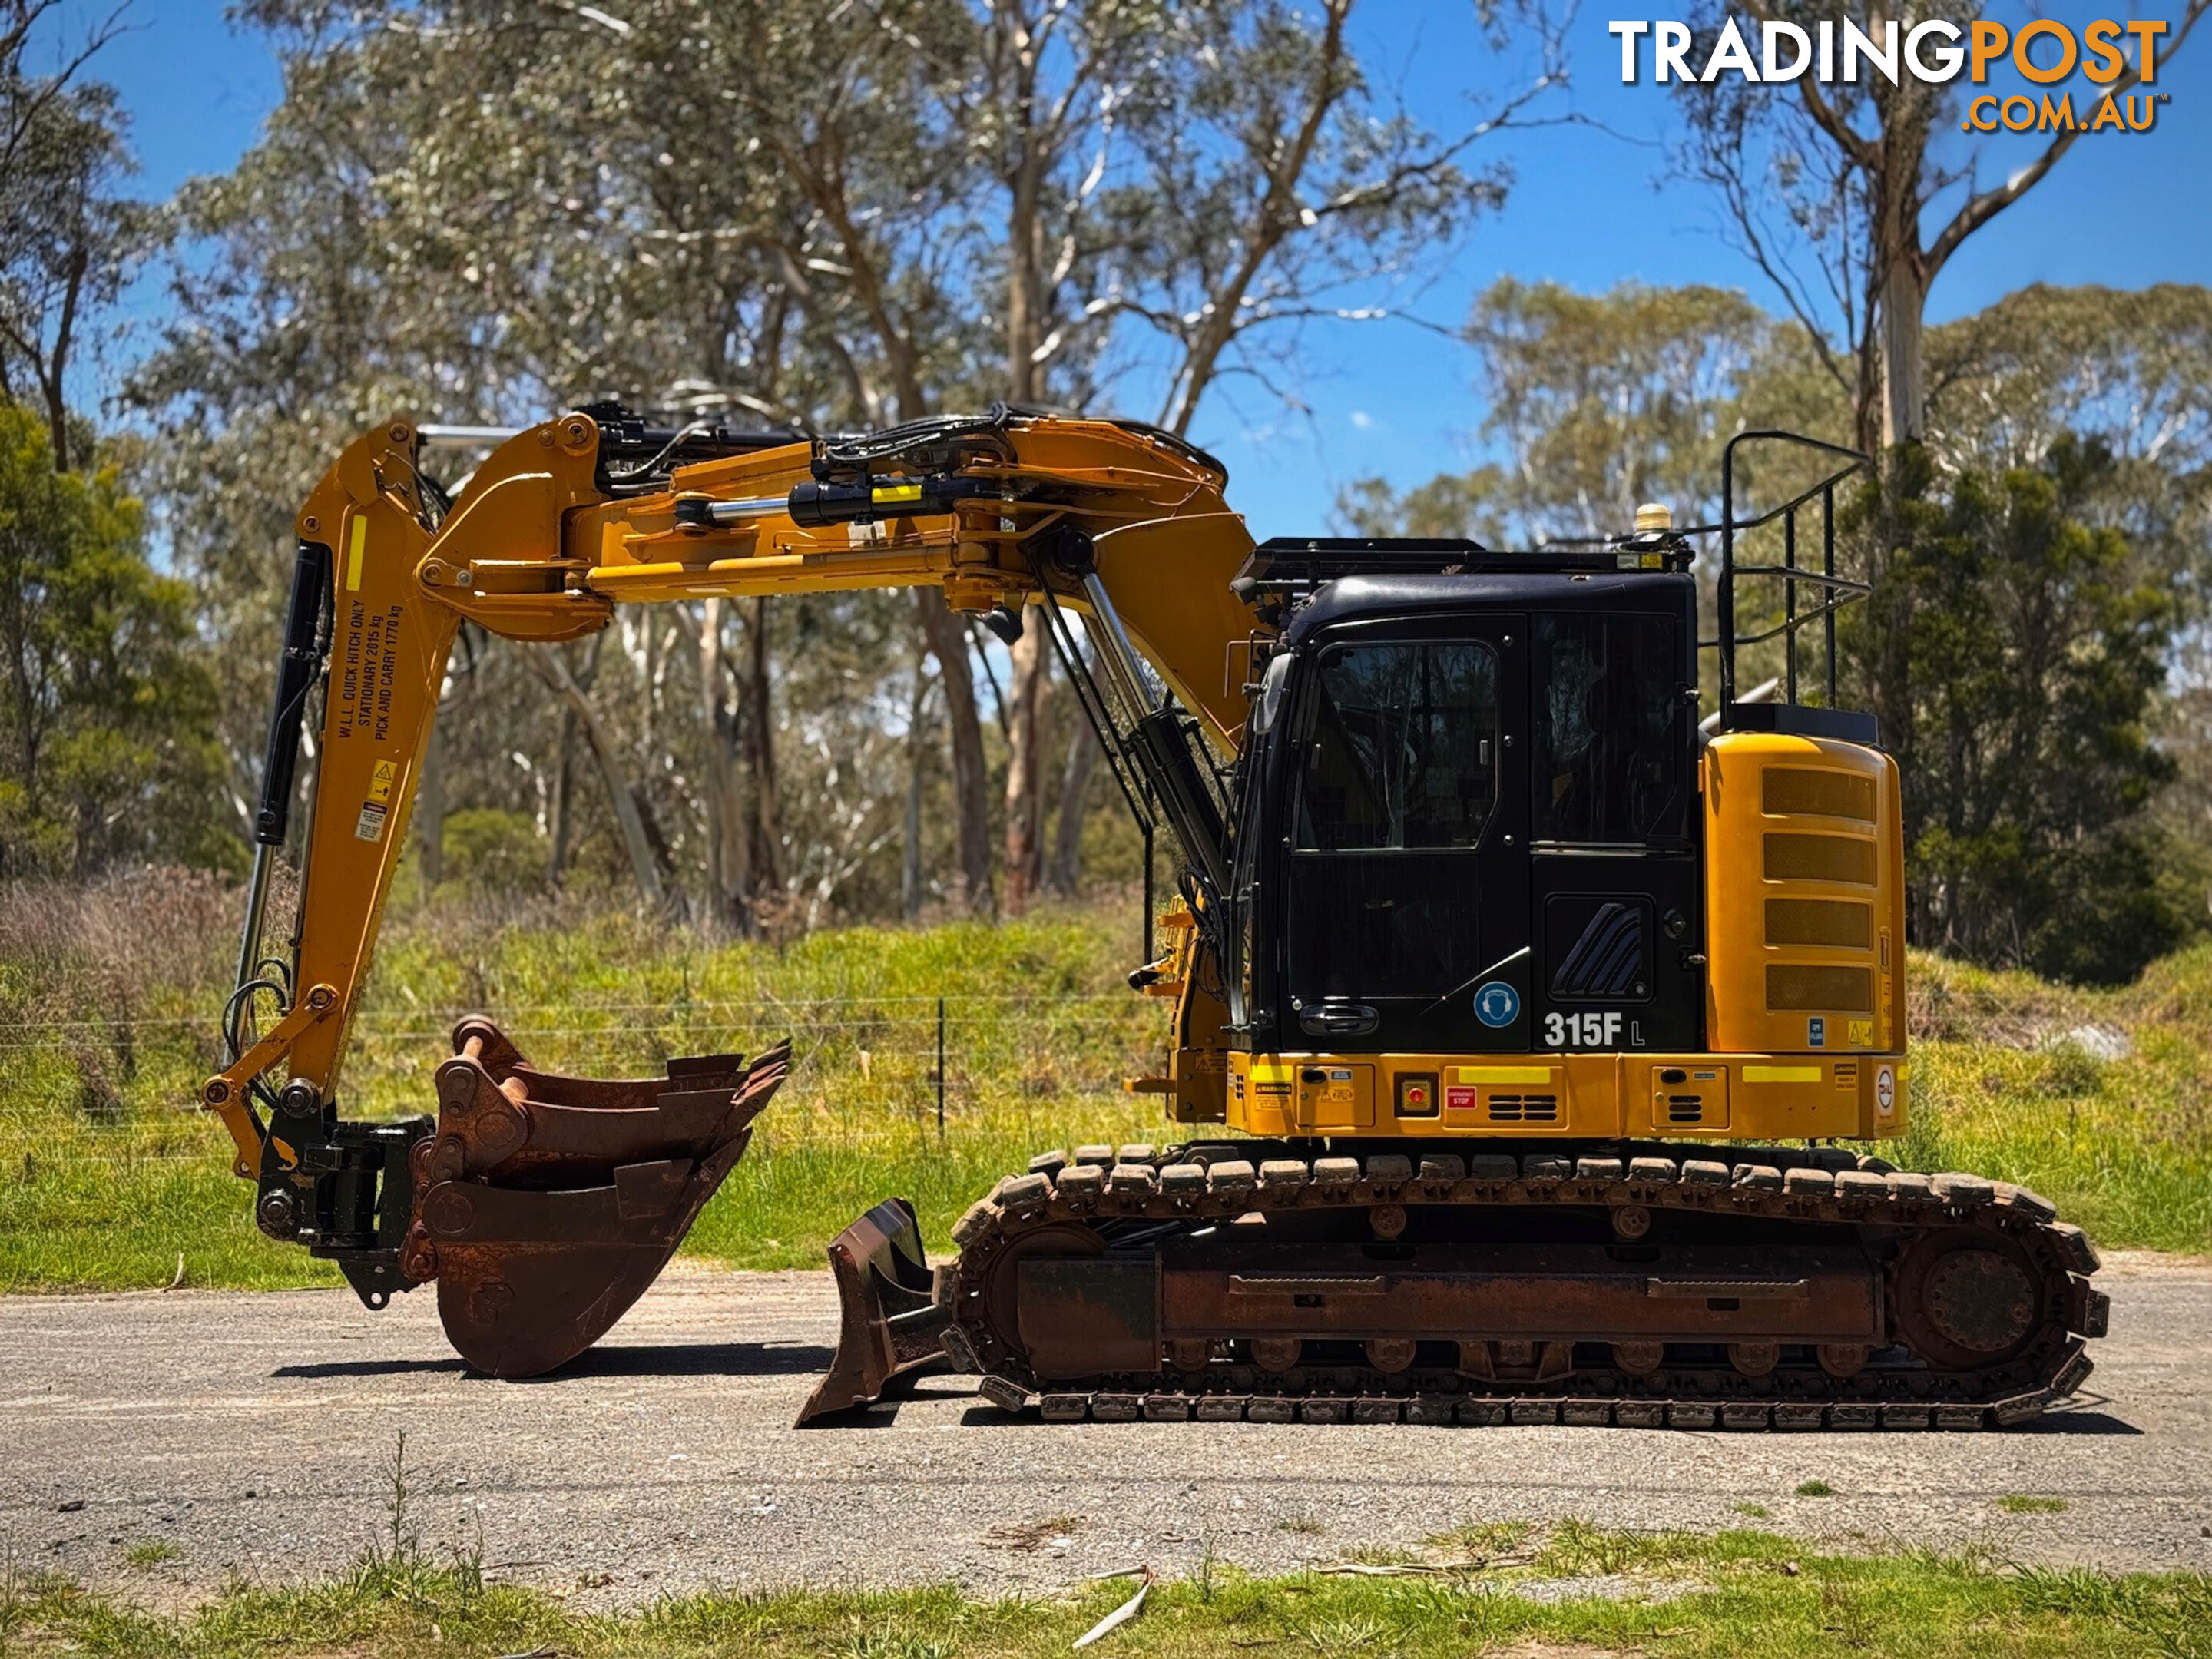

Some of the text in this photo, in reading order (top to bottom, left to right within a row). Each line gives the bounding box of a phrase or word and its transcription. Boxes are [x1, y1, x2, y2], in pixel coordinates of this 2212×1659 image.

[339, 599, 366, 738] W.L.L. QUICK HITCH ONLY
[358, 615, 384, 727] STATIONARY 2015 kg
[375, 605, 403, 740] PICK AND CARRY 1770 kg
[1544, 1012, 1645, 1046] 315F L
